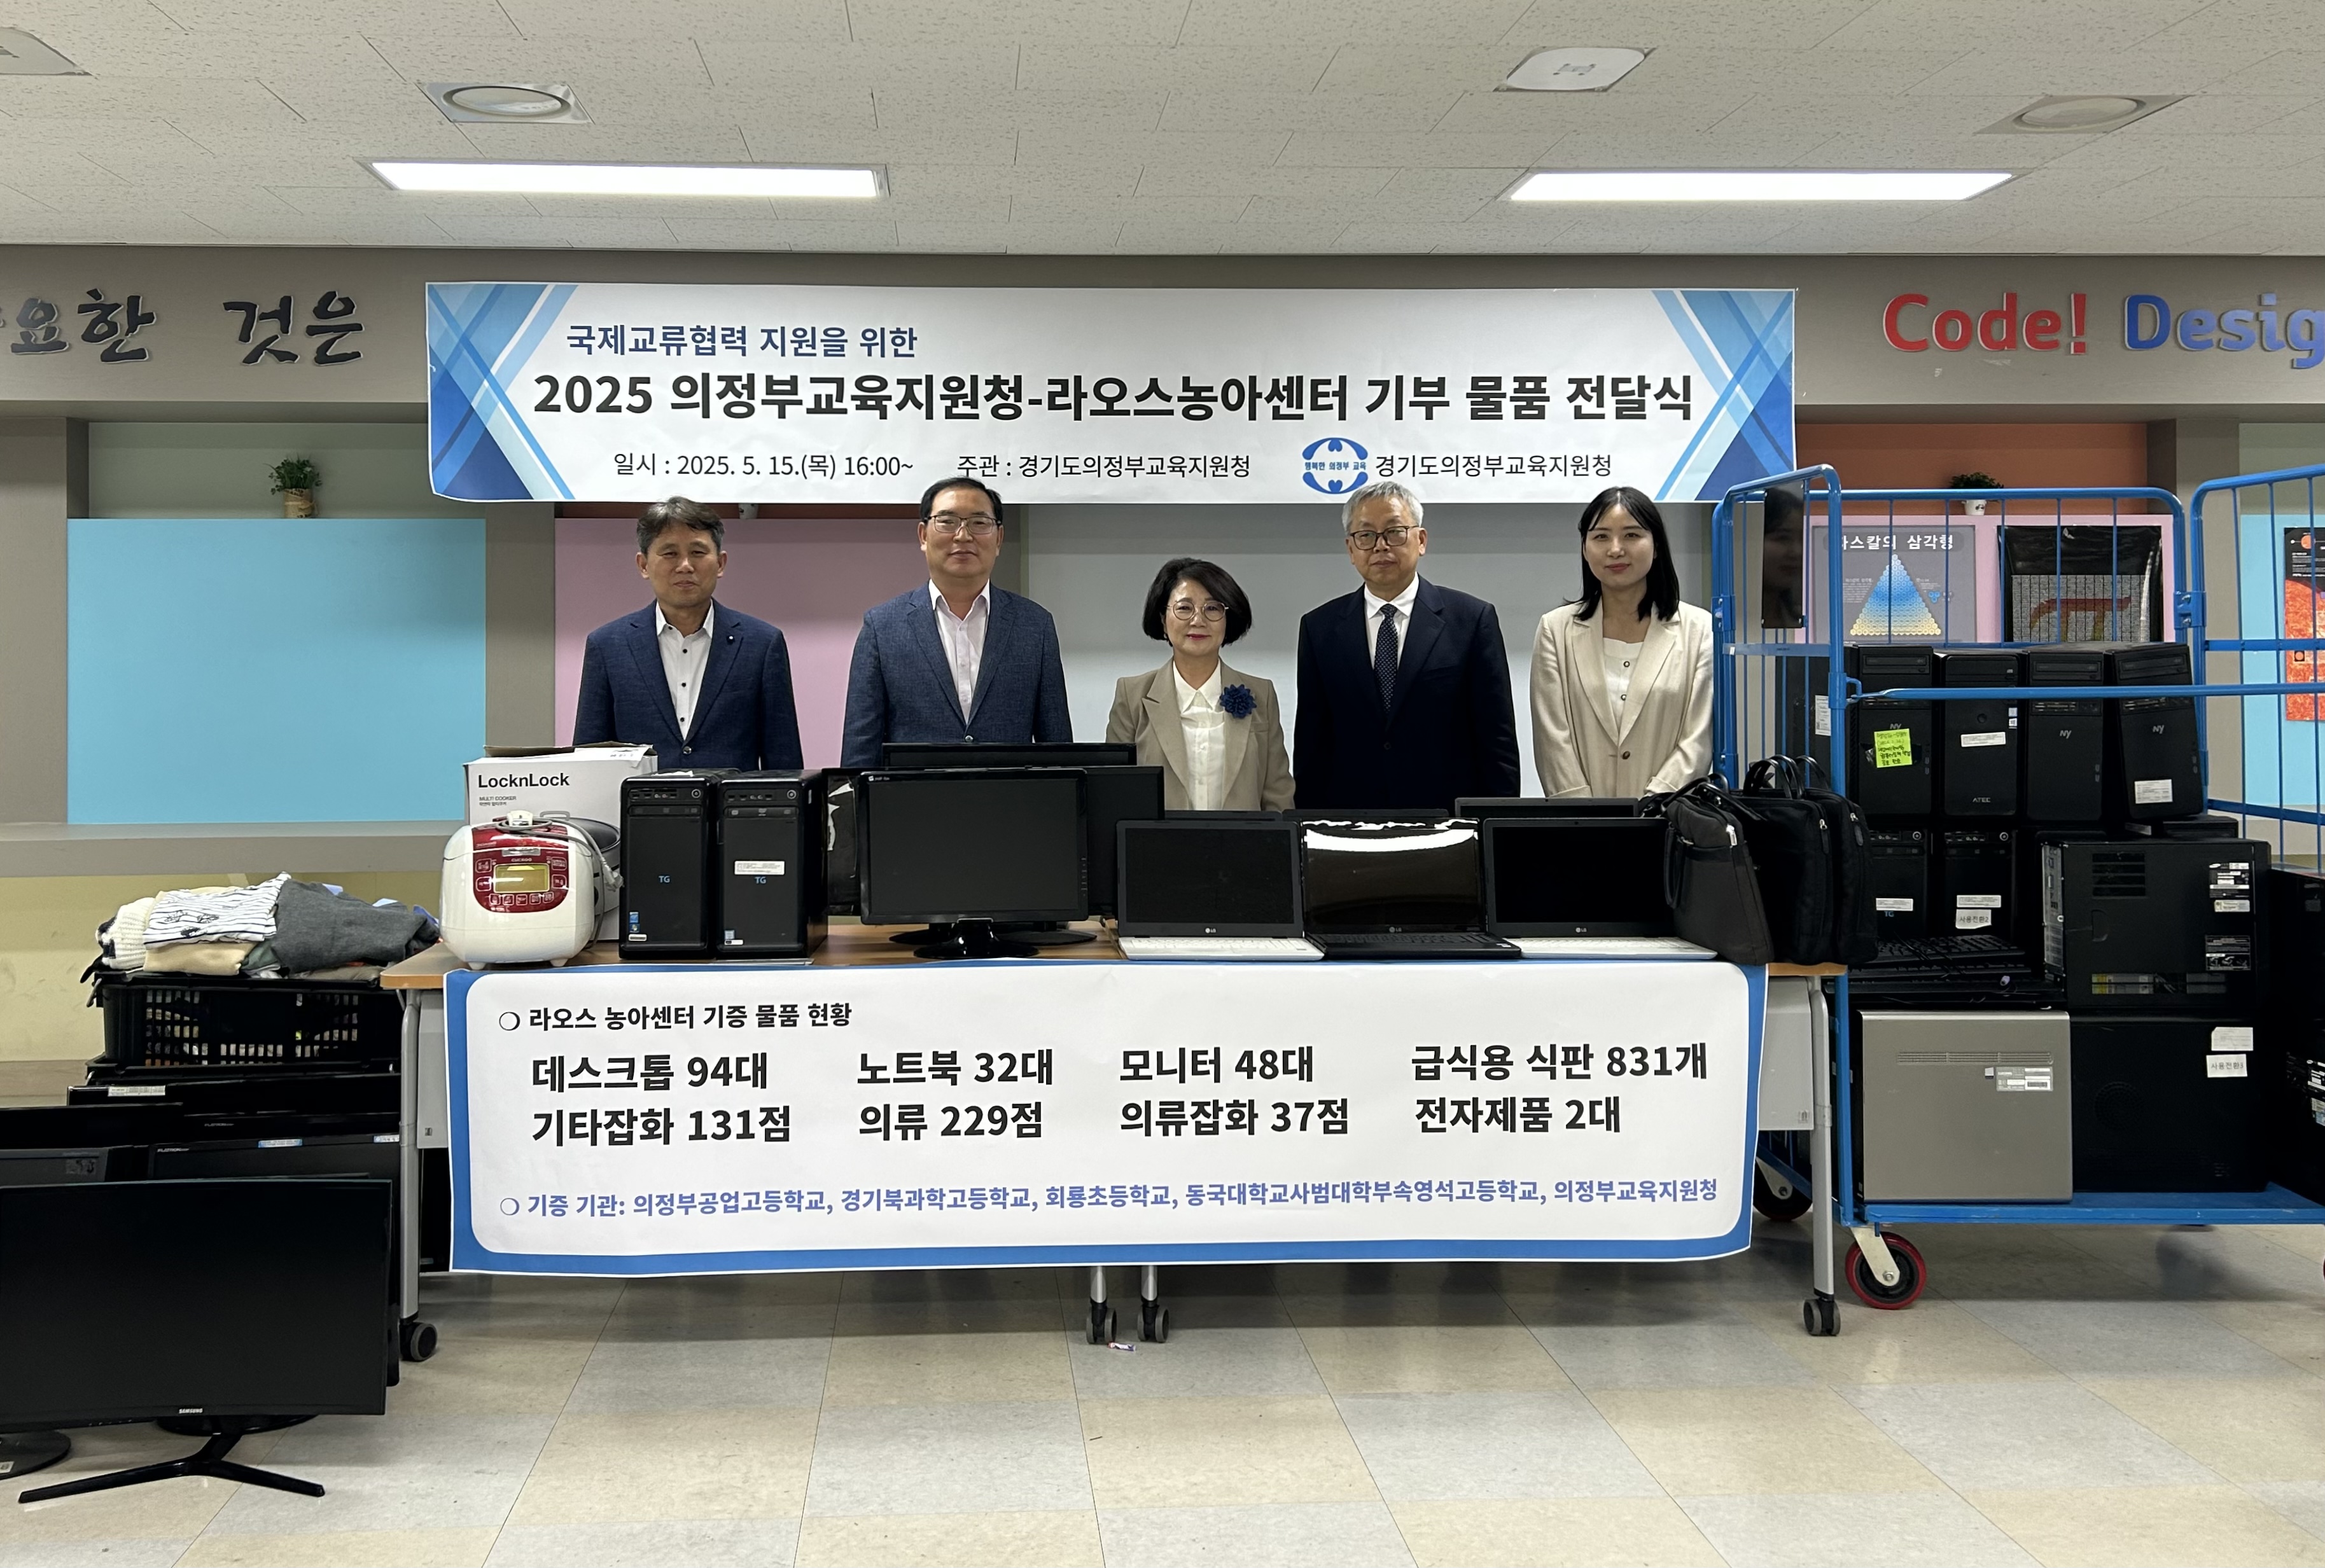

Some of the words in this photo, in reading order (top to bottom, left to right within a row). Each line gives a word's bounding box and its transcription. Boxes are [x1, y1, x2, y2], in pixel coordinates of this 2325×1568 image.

[0, 286, 160, 366] 요한
[221, 289, 367, 366] 것은
[566, 324, 746, 357] 국제교류협력
[760, 326, 848, 357] 지원을
[860, 327, 918, 358] 위한
[1882, 291, 2088, 356] Code!
[2124, 293, 2325, 370] Desig
[534, 375, 652, 414] 2025
[671, 372, 1347, 422] 의정부교육지원청-라오스농아센터
[1365, 375, 1450, 421] 기부
[1465, 376, 1551, 420] 물품
[1566, 375, 1691, 420] 전달식
[614, 452, 655, 476] 일시
[677, 455, 735, 475] 2025.
[743, 456, 760, 475] 5.
[769, 454, 835, 480] 15.(목)
[844, 456, 913, 476] 16:00~
[956, 455, 999, 478] 주관
[1019, 455, 1250, 478] 경기도의정부교육지원청
[1329, 461, 1350, 471] 의정부
[1353, 461, 1367, 471] 교육
[1376, 454, 1610, 478] 경기도의정부교육지원청
[1908, 535, 1953, 550] 삼각형
[478, 772, 570, 788] LocknLock
[529, 1007, 597, 1032] 라오스
[604, 1005, 694, 1030] 농아센터
[703, 1004, 748, 1029] 기증
[755, 1004, 800, 1028] 물품
[807, 1003, 853, 1027] 현황
[533, 1054, 674, 1093] 데스크톱
[687, 1052, 767, 1090] 94대
[857, 1050, 961, 1086] 노트북
[974, 1048, 1052, 1085] 32대
[1120, 1046, 1221, 1084] 모니터
[1234, 1046, 1313, 1083] 48대
[1411, 1044, 1514, 1081] 급식용
[1526, 1043, 1595, 1080] 식판
[1607, 1042, 1707, 1079] 831개
[532, 1107, 674, 1147] 기타잡화
[688, 1105, 790, 1142] 131점
[859, 1103, 928, 1141] 의류
[940, 1101, 1042, 1139] 229점
[1120, 1099, 1259, 1137] 의류잡화
[1271, 1098, 1348, 1135] 37점
[1415, 1096, 1553, 1134] 전자제품
[1565, 1095, 1621, 1133] 2대
[527, 1194, 569, 1218] 기증
[576, 1194, 625, 1218] 기관:
[633, 1190, 833, 1217] 의정부공업고등학교,
[841, 1186, 1038, 1212] 경기북과학고등학교,
[1045, 1184, 1178, 1210] 회룡초등학교,
[1185, 1179, 1547, 1207] 동국대학교사범대학부속영석고등학교,
[1554, 1178, 1717, 1203] 의정부교육지원청
